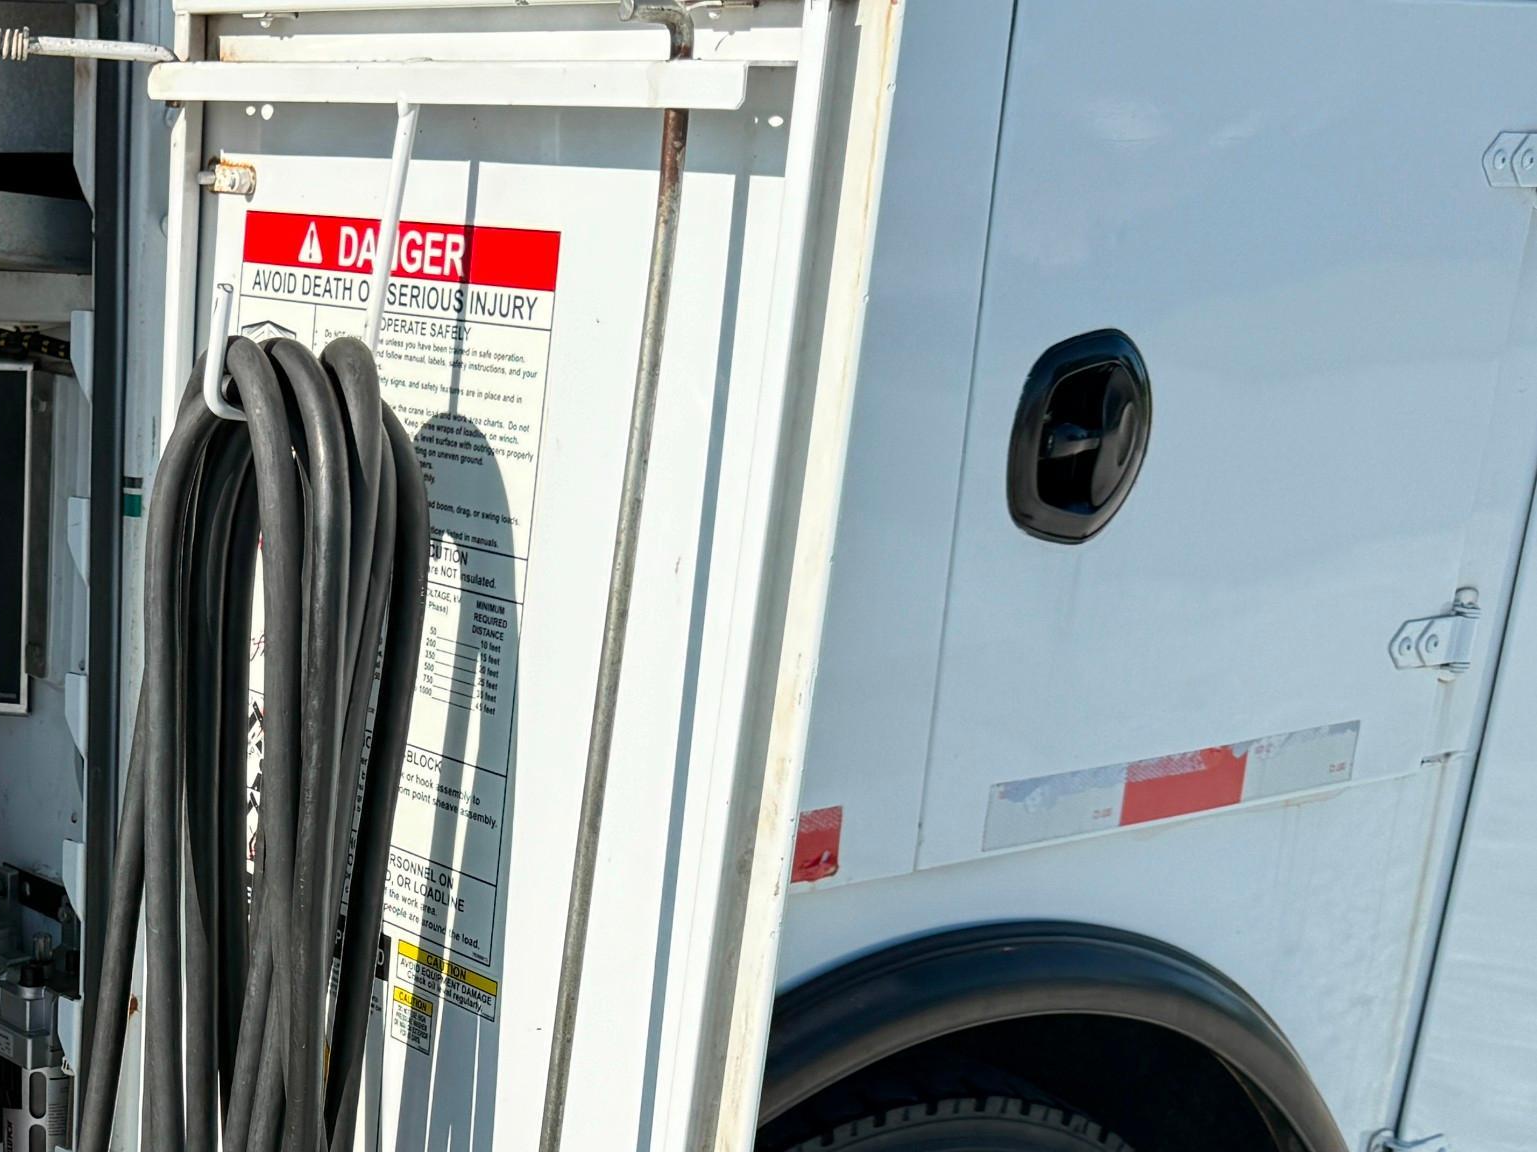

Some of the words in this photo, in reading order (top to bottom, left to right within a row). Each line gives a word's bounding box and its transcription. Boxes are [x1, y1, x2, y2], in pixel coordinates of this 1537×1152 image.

[338, 226, 465, 276] DAGER
[252, 270, 296, 293] AVOID
[302, 275, 353, 302] DEATH
[386, 282, 463, 313] SERIOUS
[470, 291, 538, 321] INJURY
[430, 323, 471, 341] SAFELY
[385, 339, 403, 348] unless
[417, 341, 432, 351] have
[433, 343, 448, 352] been
[471, 349, 477, 357] in
[479, 349, 491, 359] safe
[493, 352, 525, 363] operation.
[385, 350, 402, 360] follow
[404, 353, 426, 363] manual,
[428, 355, 446, 366] labels,
[468, 361, 507, 374] instructions,
[509, 366, 521, 376] and
[522, 369, 538, 379] your
[391, 378, 406, 389] signs,
[408, 379, 420, 388] and
[421, 381, 438, 393] safety
[466, 388, 475, 396] are
[477, 389, 483, 398] in
[484, 391, 500, 402] place
[502, 393, 515, 403] and
[516, 395, 522, 404] in
[409, 406, 424, 415] crane
[483, 417, 504, 428] charts.
[508, 420, 517, 431] Do
[519, 424, 530, 433] not
[436, 436, 457, 448] surface
[459, 440, 471, 449] with
[506, 450, 534, 463] properly
[499, 434, 519, 445] winch.
[460, 454, 483, 465] ground.
[437, 501, 455, 513] boom,
[456, 506, 471, 518] drag,
[473, 509, 480, 517] or
[481, 512, 500, 524] swing
[441, 565, 458, 578] NOT
[476, 600, 505, 615] MINIMUM
[474, 612, 507, 628] REQUIRED
[472, 625, 504, 640] DISTANCE
[426, 638, 436, 648] 200
[488, 654, 500, 666] feet
[489, 641, 501, 653] feet
[487, 666, 499, 678] feet
[486, 678, 498, 690] feet
[485, 690, 497, 703] feet
[484, 703, 496, 715] feet
[412, 788, 431, 803] point
[416, 775, 433, 788] hook
[472, 795, 480, 805] to
[390, 854, 436, 883] RSONNEL
[439, 875, 454, 889] ON
[390, 889, 399, 899] the
[402, 893, 419, 909] work
[397, 874, 411, 891] OR
[414, 881, 464, 913] LOADLINE
[409, 913, 419, 923] are
[462, 936, 480, 950] load.
[427, 955, 467, 981] CAUTION
[462, 981, 491, 1006] DAMAGE
